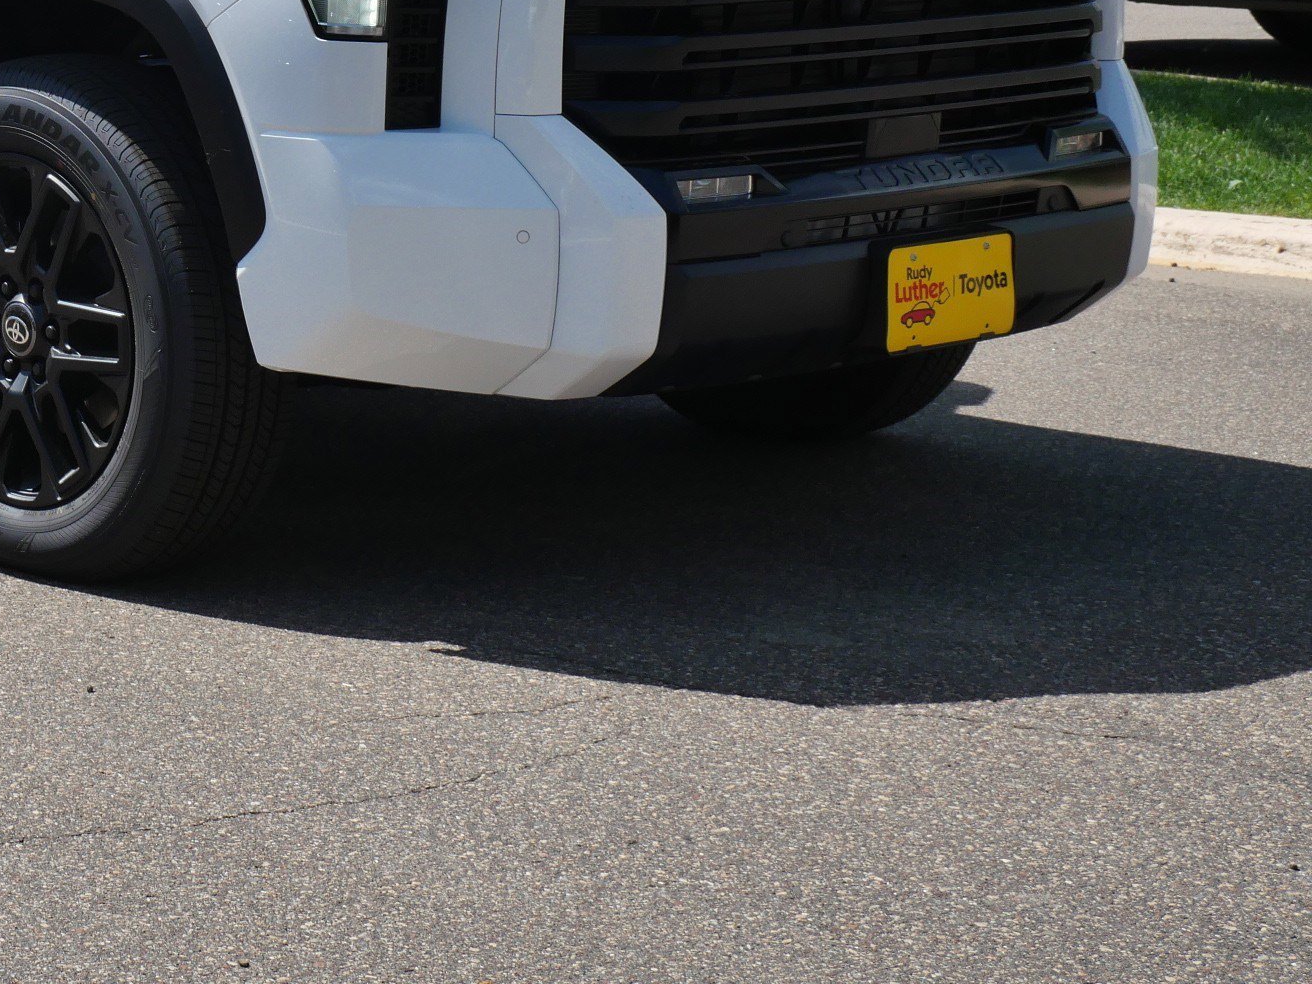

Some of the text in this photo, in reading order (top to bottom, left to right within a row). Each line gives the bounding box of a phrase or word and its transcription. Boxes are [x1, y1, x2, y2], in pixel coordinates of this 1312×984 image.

[854, 151, 1005, 192] TUNDRA
[906, 265, 933, 281] Rudy
[959, 269, 1008, 297] Toyota
[895, 279, 945, 304] Luther
